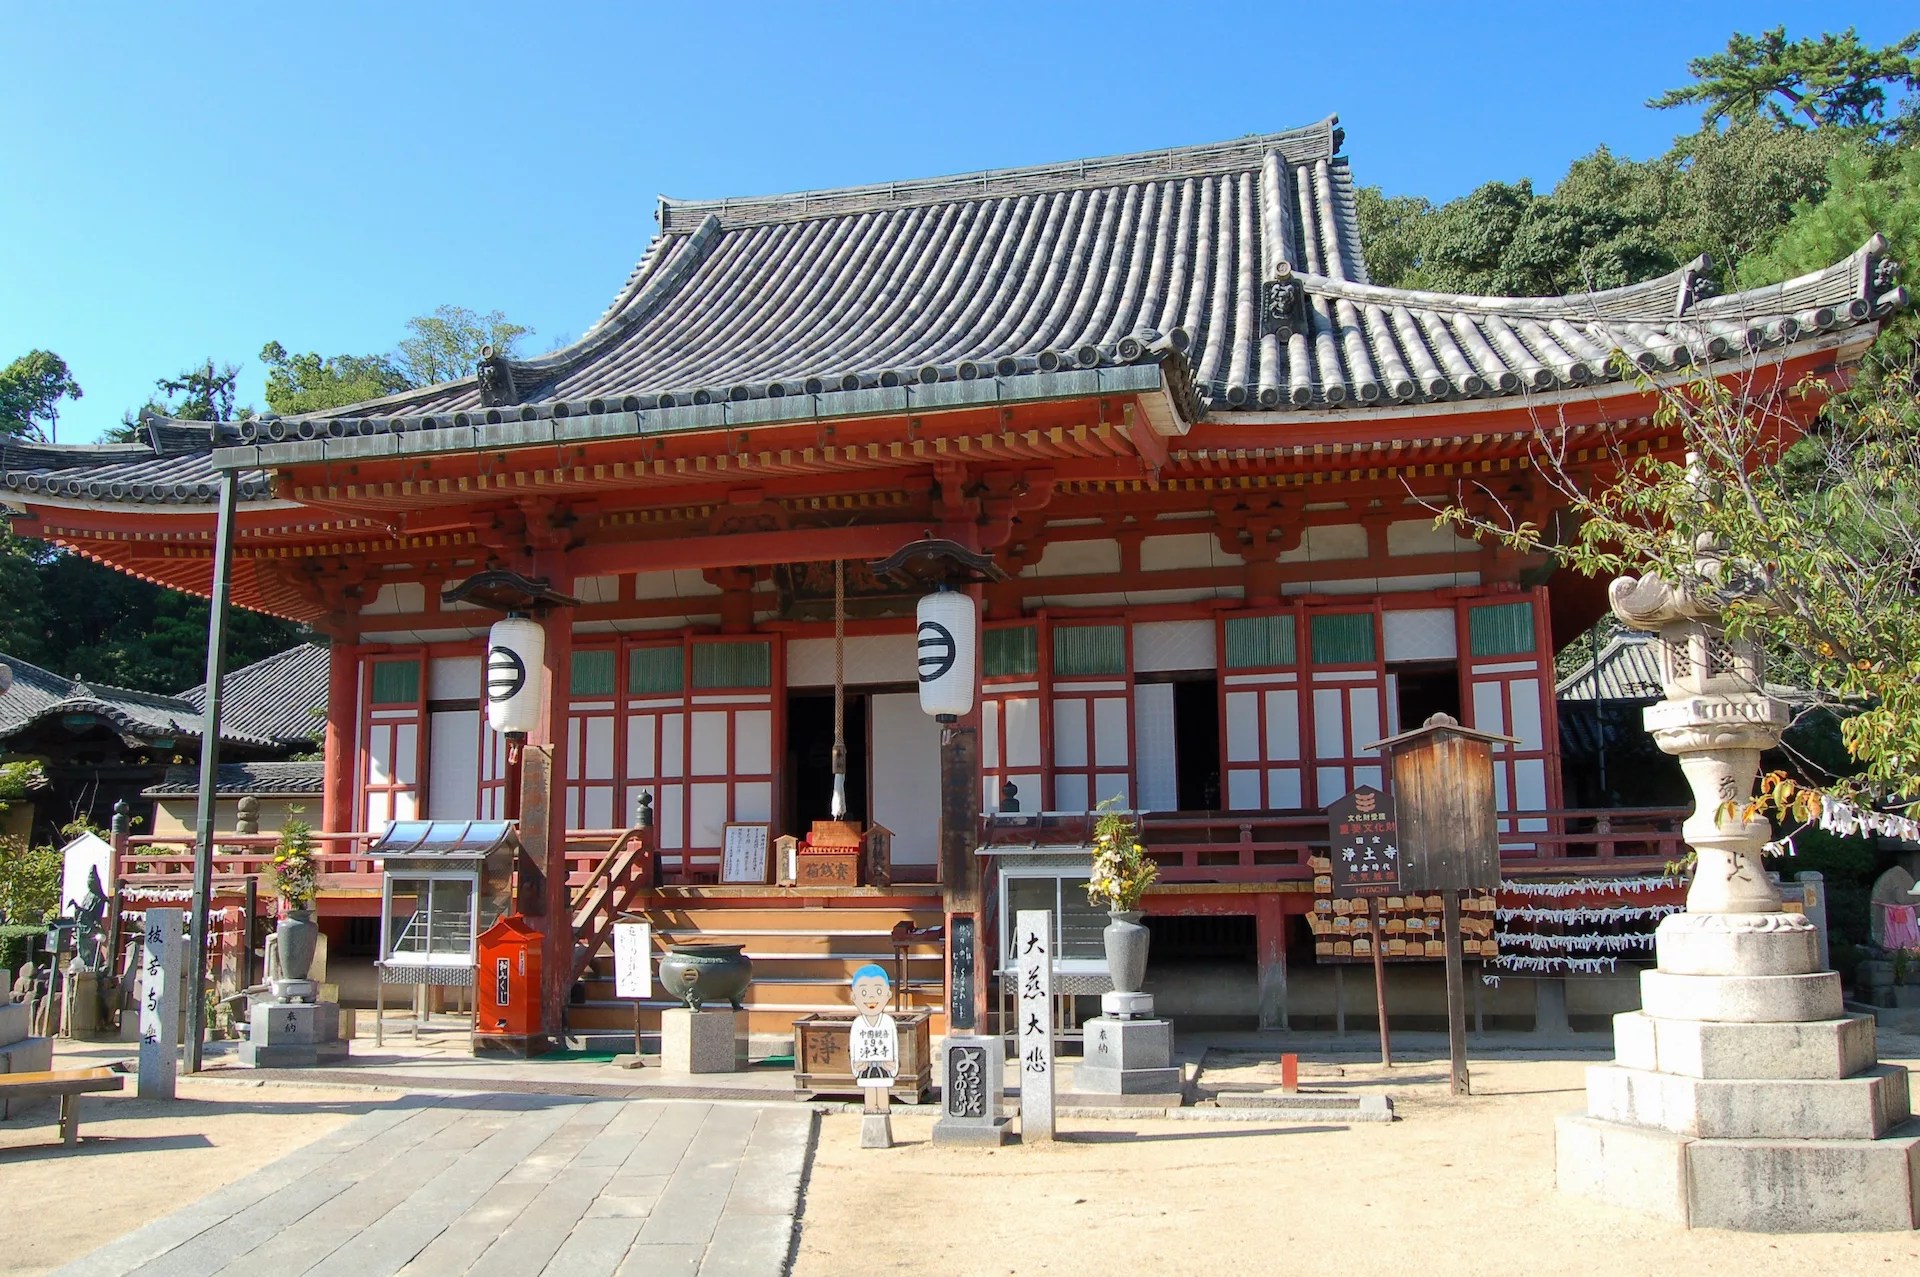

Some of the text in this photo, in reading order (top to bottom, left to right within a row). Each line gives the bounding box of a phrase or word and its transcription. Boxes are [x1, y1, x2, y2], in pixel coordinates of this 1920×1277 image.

[1347, 812, 1387, 822] 文化財愛護
[1339, 822, 1396, 835] 重要文化財
[1349, 862, 1391, 872] 鎌倉時代
[1355, 886, 1390, 895] HITACHI
[498, 960, 508, 1004] おみくじ
[1022, 931, 1047, 1074] 大慈大悲
[1097, 1028, 1109, 1055] 奉納
